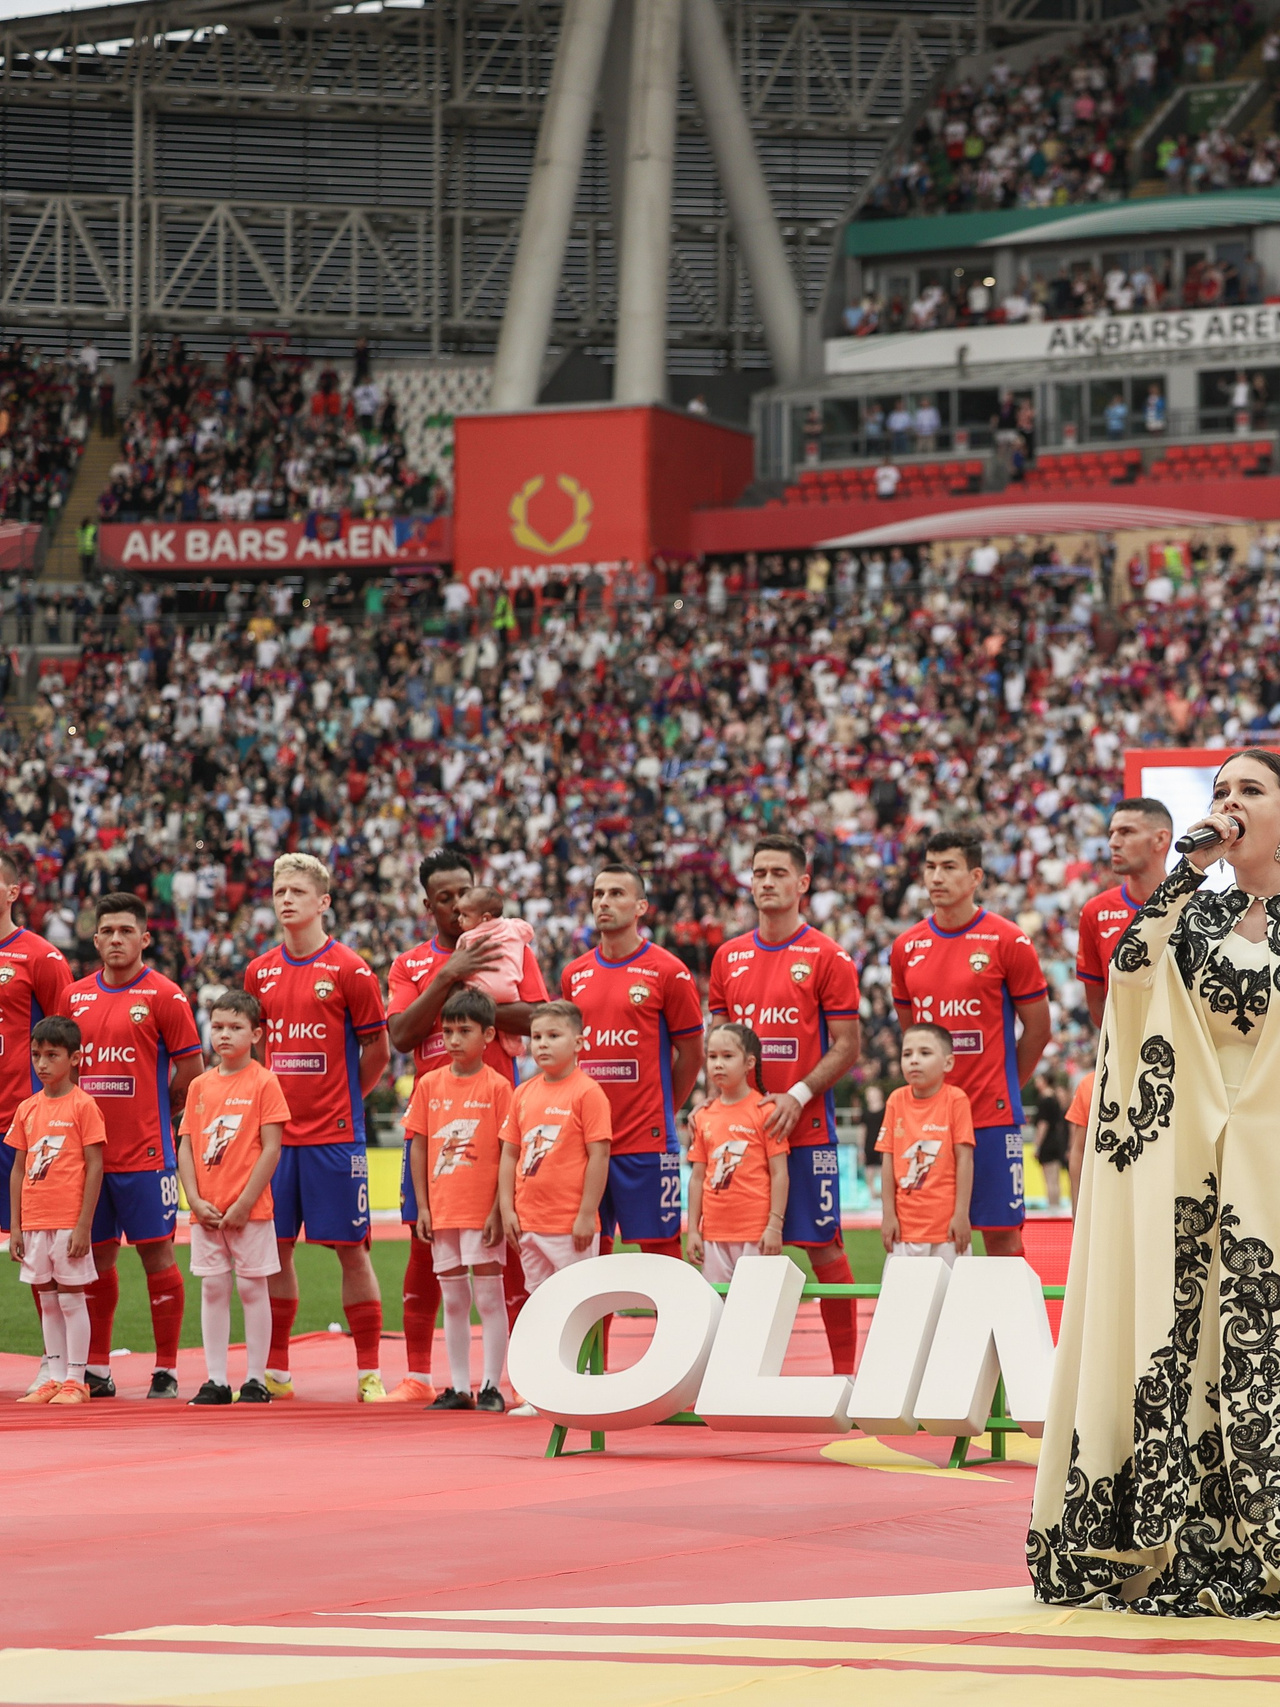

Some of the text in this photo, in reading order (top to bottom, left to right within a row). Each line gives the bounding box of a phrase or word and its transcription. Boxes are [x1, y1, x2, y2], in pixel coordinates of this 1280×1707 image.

[1048, 325, 1093, 352] AK
[1102, 316, 1196, 350] BARS
[121, 528, 177, 564] AK
[185, 527, 289, 563] BARS
[759, 1006, 800, 1025] ИКС
[939, 998, 981, 1018] ИКС
[288, 1022, 327, 1040] ИКС
[596, 1029, 639, 1047] ИКС
[98, 1046, 136, 1063] ИКС
[160, 1175, 179, 1207] 88
[357, 1183, 368, 1213] 6
[660, 1175, 681, 1208] 22
[819, 1179, 833, 1212] 5
